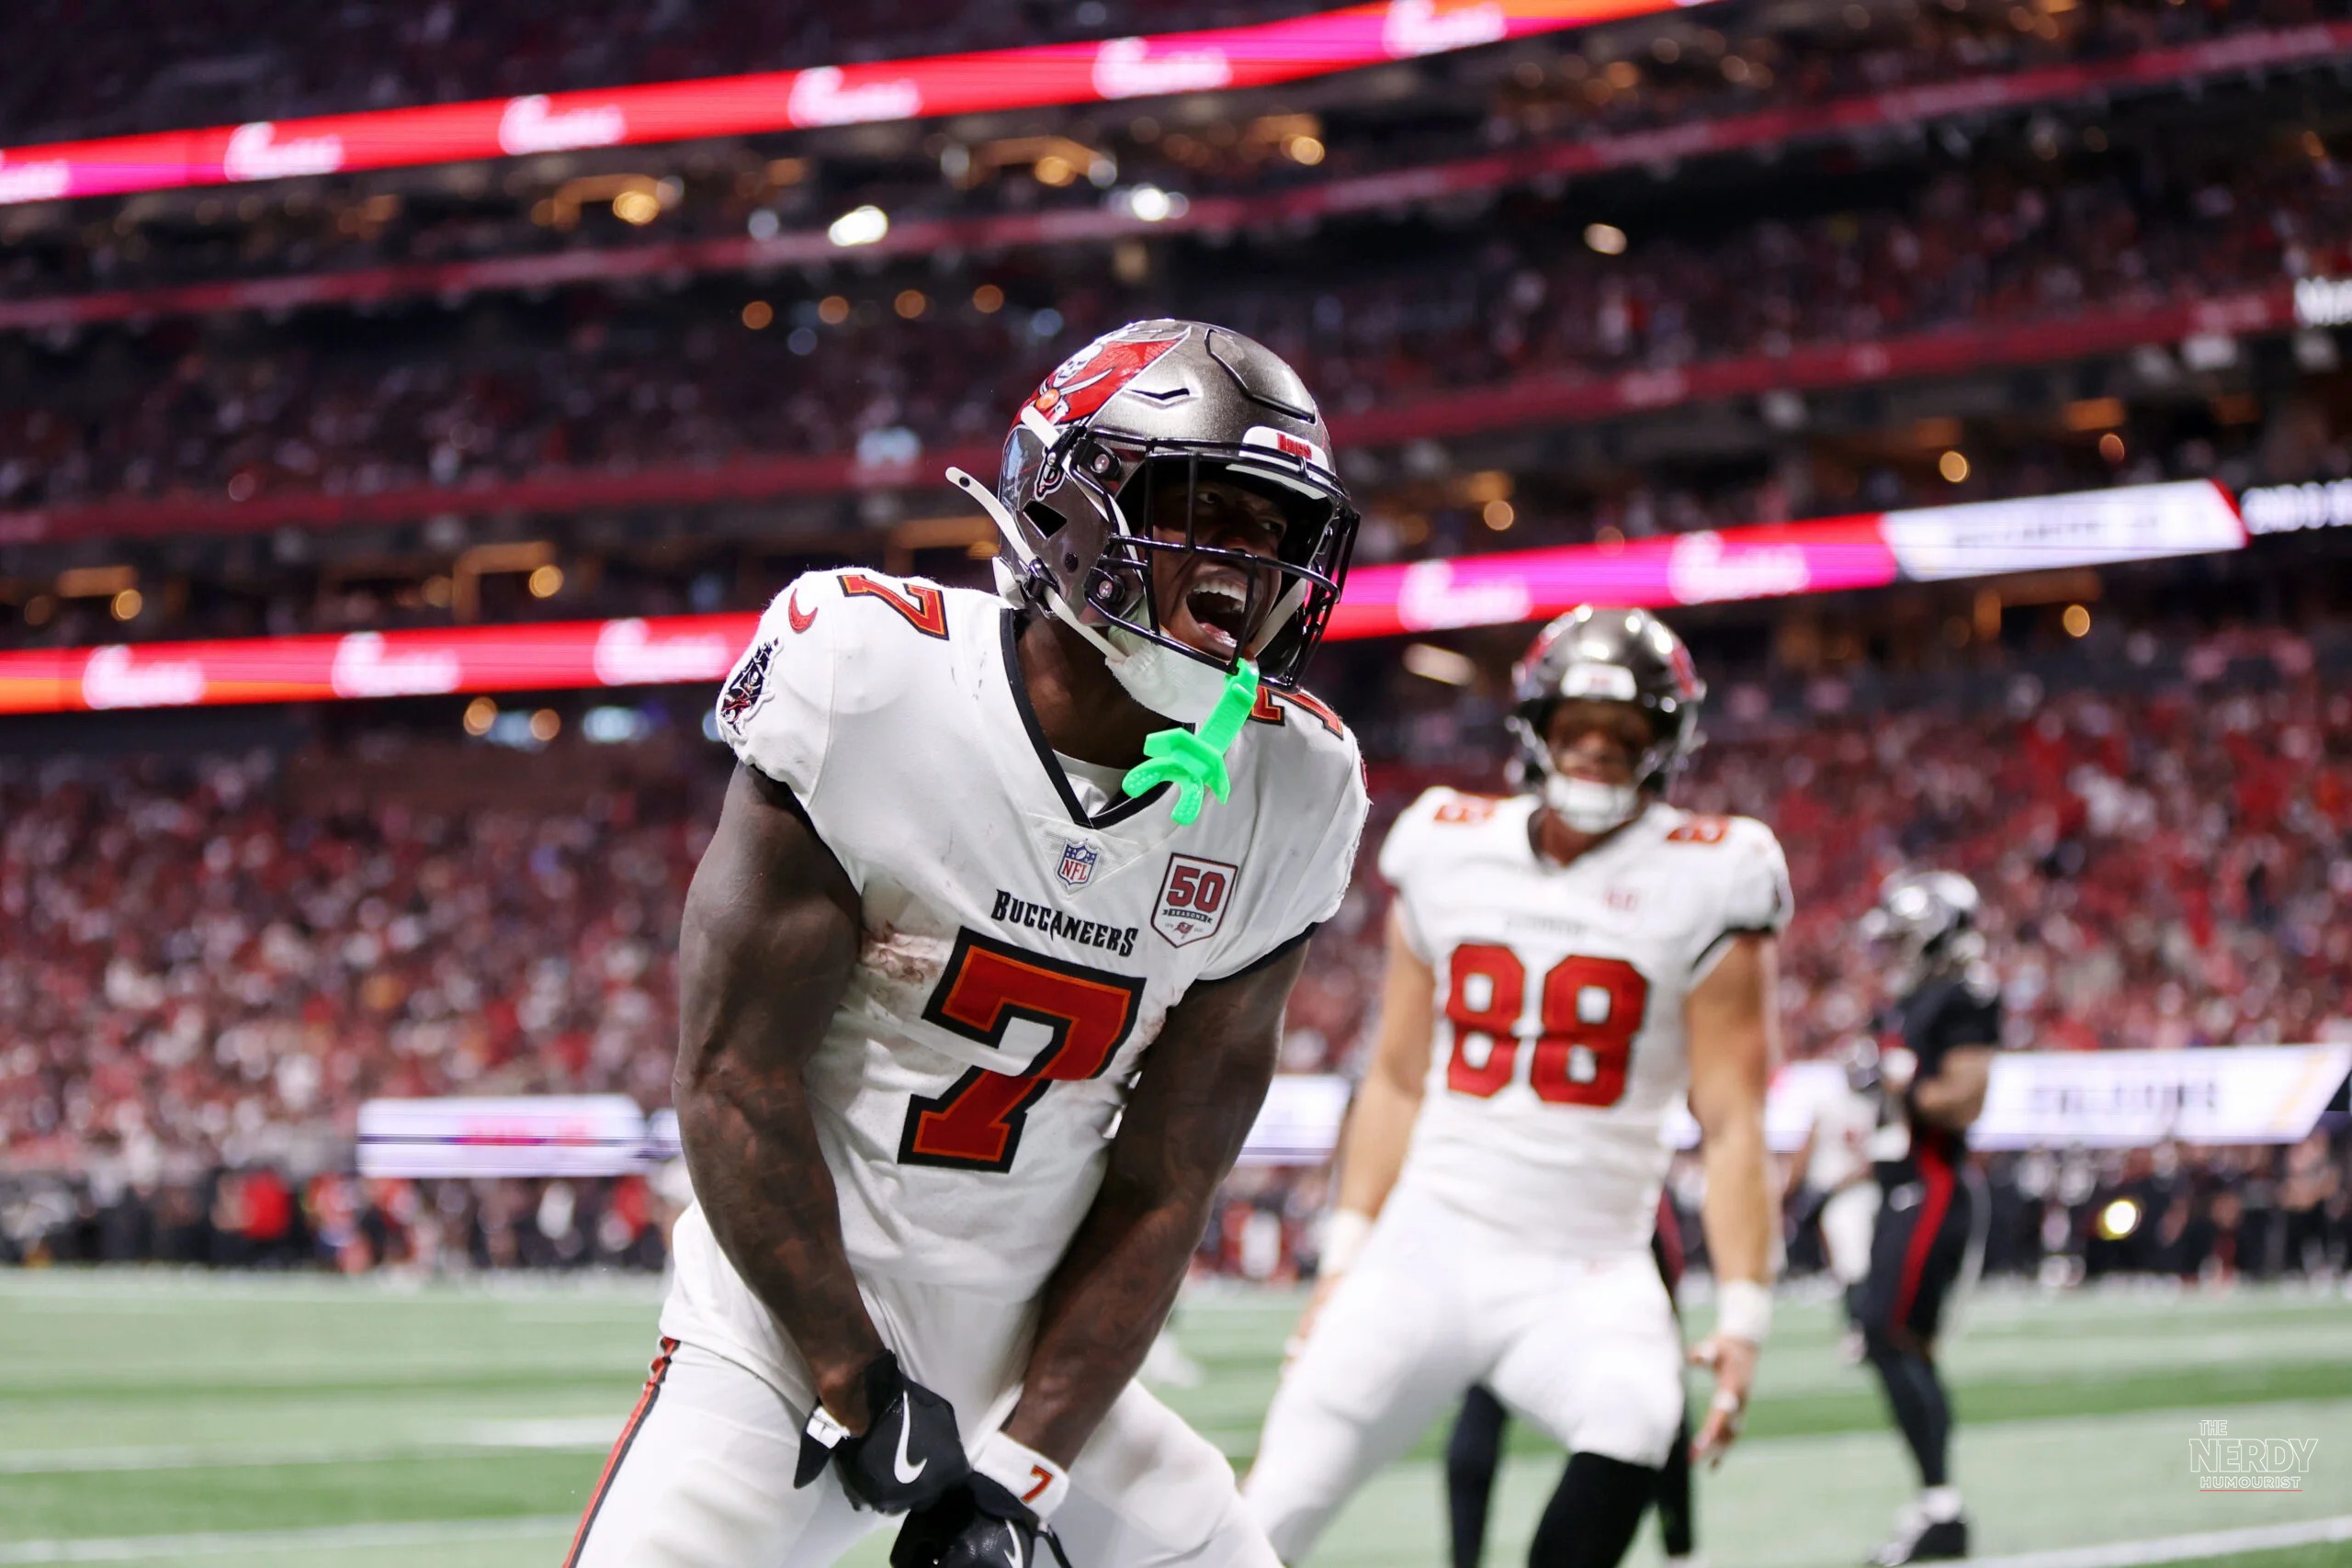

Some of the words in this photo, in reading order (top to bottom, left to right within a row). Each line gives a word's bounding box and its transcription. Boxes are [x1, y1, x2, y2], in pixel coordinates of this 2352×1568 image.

[837, 574, 950, 641] 7
[1061, 859, 1088, 881] NFL
[1166, 864, 1227, 914] 50
[990, 889, 1139, 957] BUCCANEERS
[1170, 909, 1206, 921] SEASONS
[897, 926, 1147, 1174] 7
[1445, 942, 1650, 1109] 88
[1020, 1464, 1054, 1505] 7
